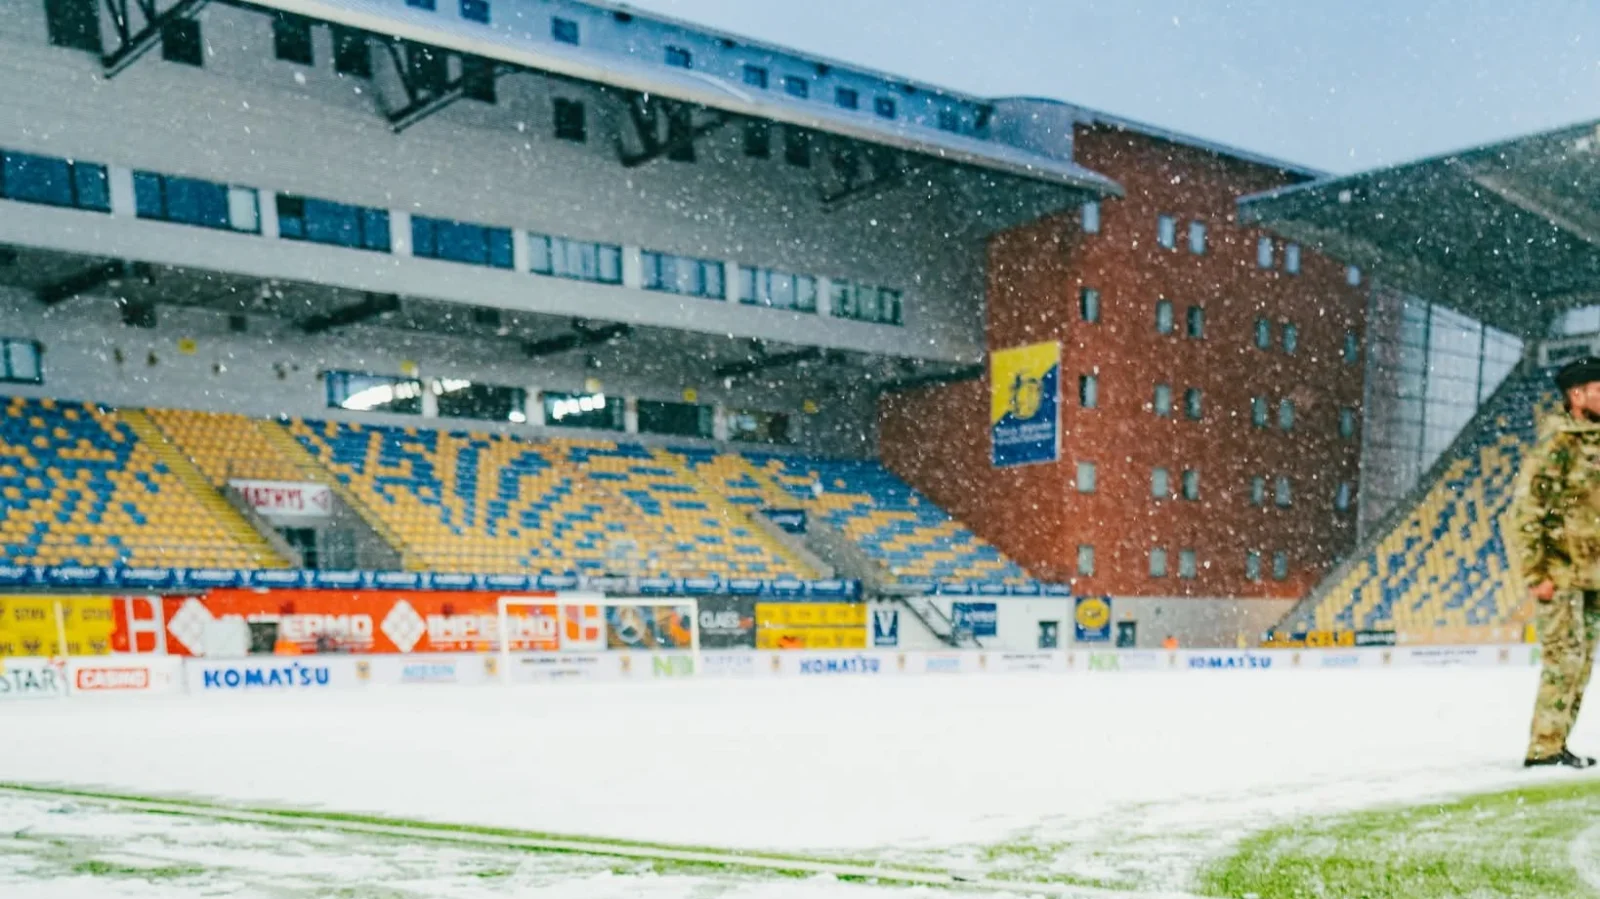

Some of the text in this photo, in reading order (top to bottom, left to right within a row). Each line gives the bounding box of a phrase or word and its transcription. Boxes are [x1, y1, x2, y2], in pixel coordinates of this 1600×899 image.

[799, 656, 880, 674] KOMATSU
[1187, 653, 1273, 670] KOMATSU
[203, 661, 331, 688] KOMATSU
